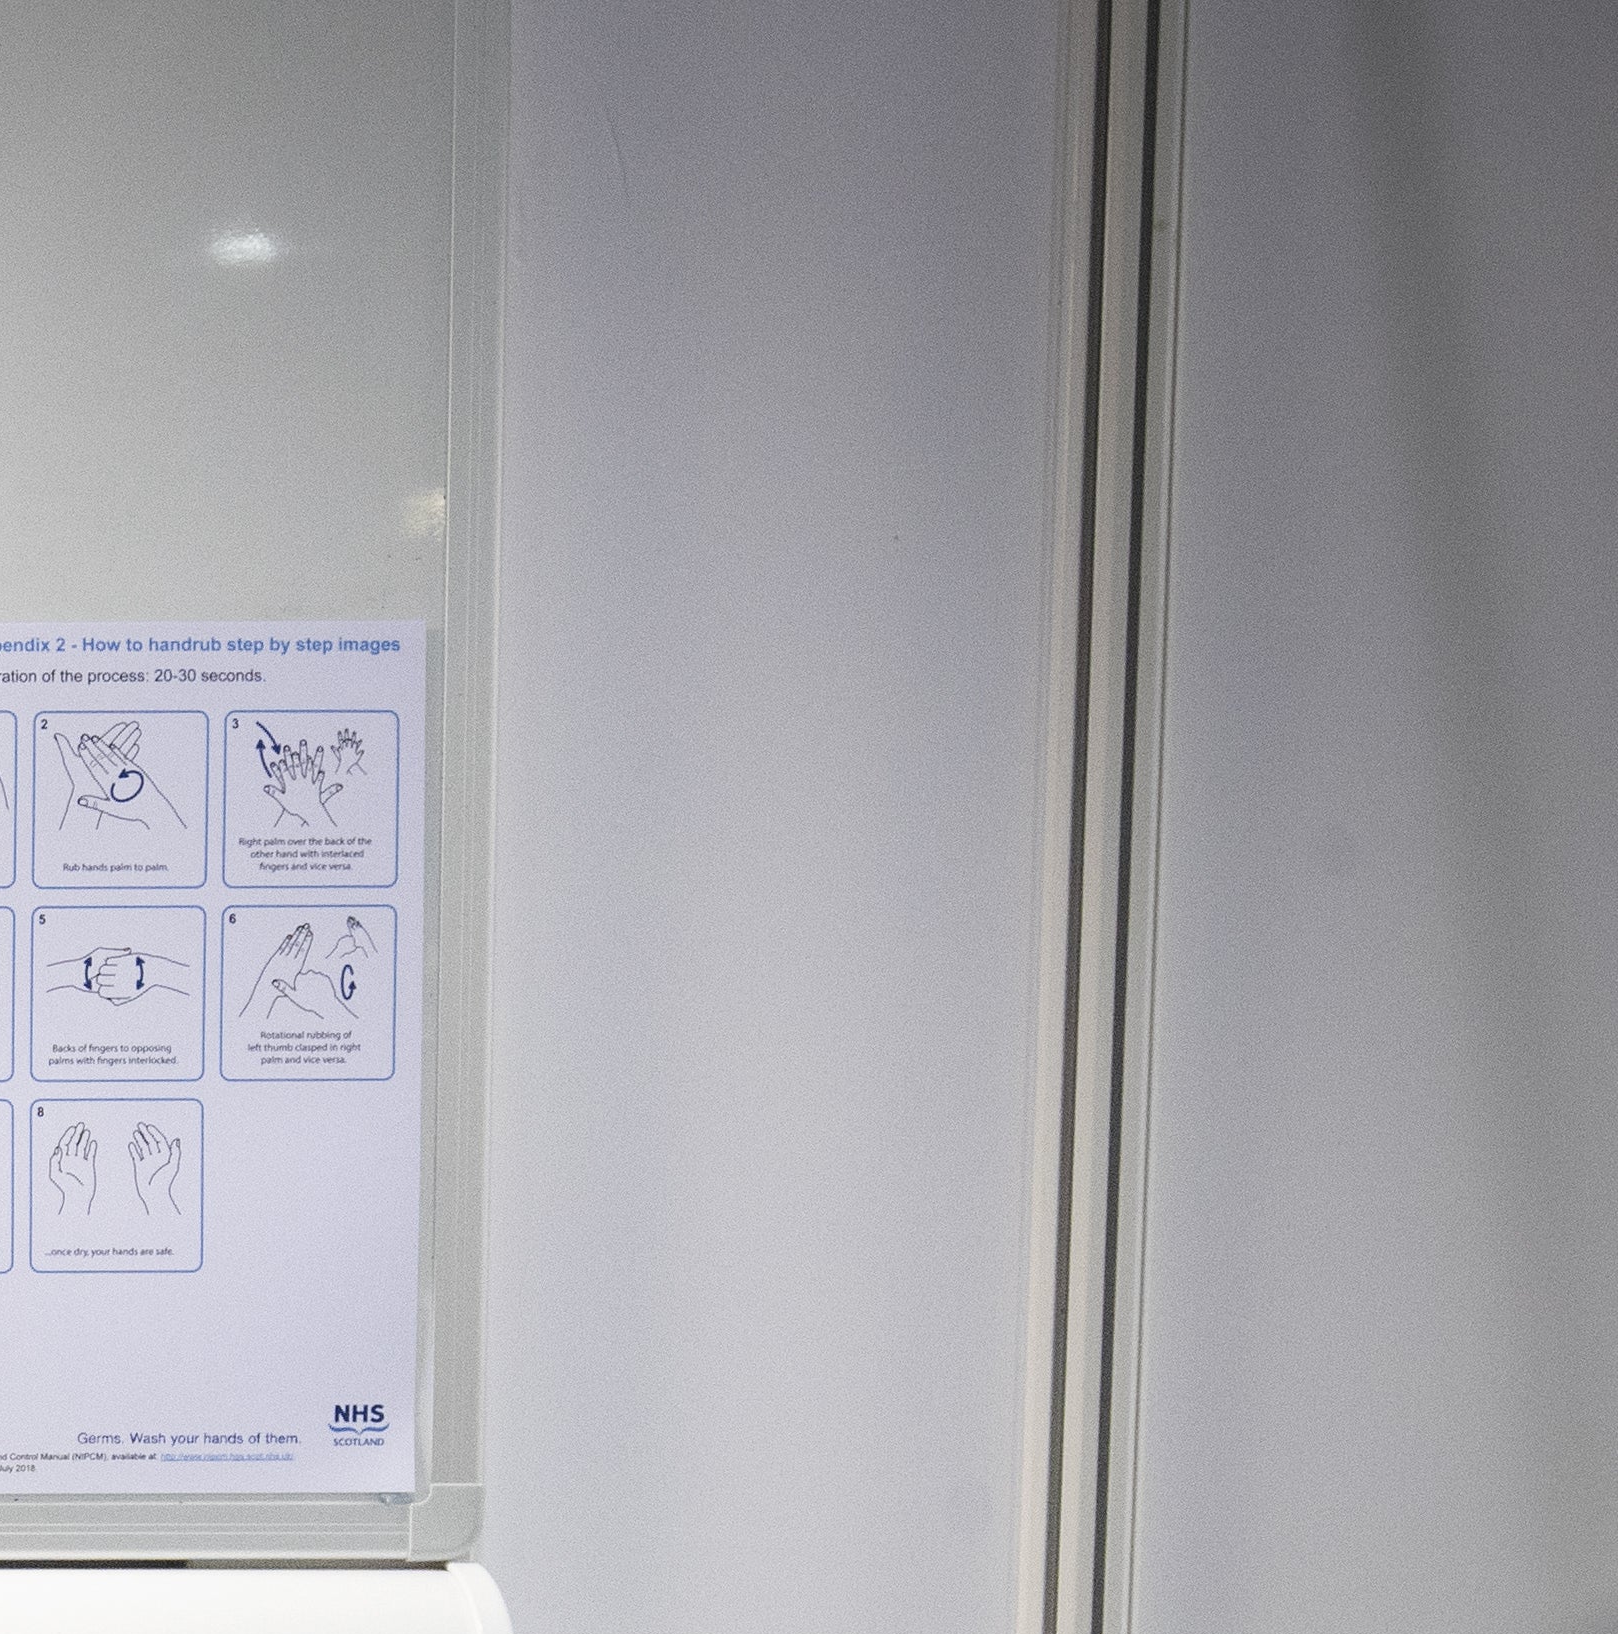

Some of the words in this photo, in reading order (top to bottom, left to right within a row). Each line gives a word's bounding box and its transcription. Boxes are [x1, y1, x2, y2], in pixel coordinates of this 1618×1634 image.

[55, 636, 66, 653] 2
[81, 637, 122, 653] How
[125, 638, 144, 653] to
[148, 636, 223, 653] handrub
[226, 637, 265, 655] step
[268, 636, 291, 656] by
[295, 637, 334, 656] step
[337, 637, 401, 656] images
[40, 668, 57, 684] of
[59, 669, 84, 684] the
[86, 671, 149, 686] process:
[153, 668, 197, 683] 20-30
[200, 668, 266, 683] seconds.
[40, 718, 49, 731] 2
[231, 717, 240, 730] 3
[62, 862, 81, 872] Rub
[81, 863, 109, 872] hands
[109, 863, 133, 873] palm
[133, 863, 144, 872] to
[38, 913, 47, 926] 5
[227, 912, 238, 925] 6
[36, 1105, 45, 1118] 8
[90, 1249, 111, 1258] your
[111, 1247, 139, 1256] hands
[333, 1403, 386, 1425] NHS
[129, 1432, 167, 1445] Wash
[169, 1434, 200, 1447] your
[203, 1432, 245, 1445] hands
[247, 1431, 262, 1445] of
[332, 1437, 385, 1447] SCOTLAND
